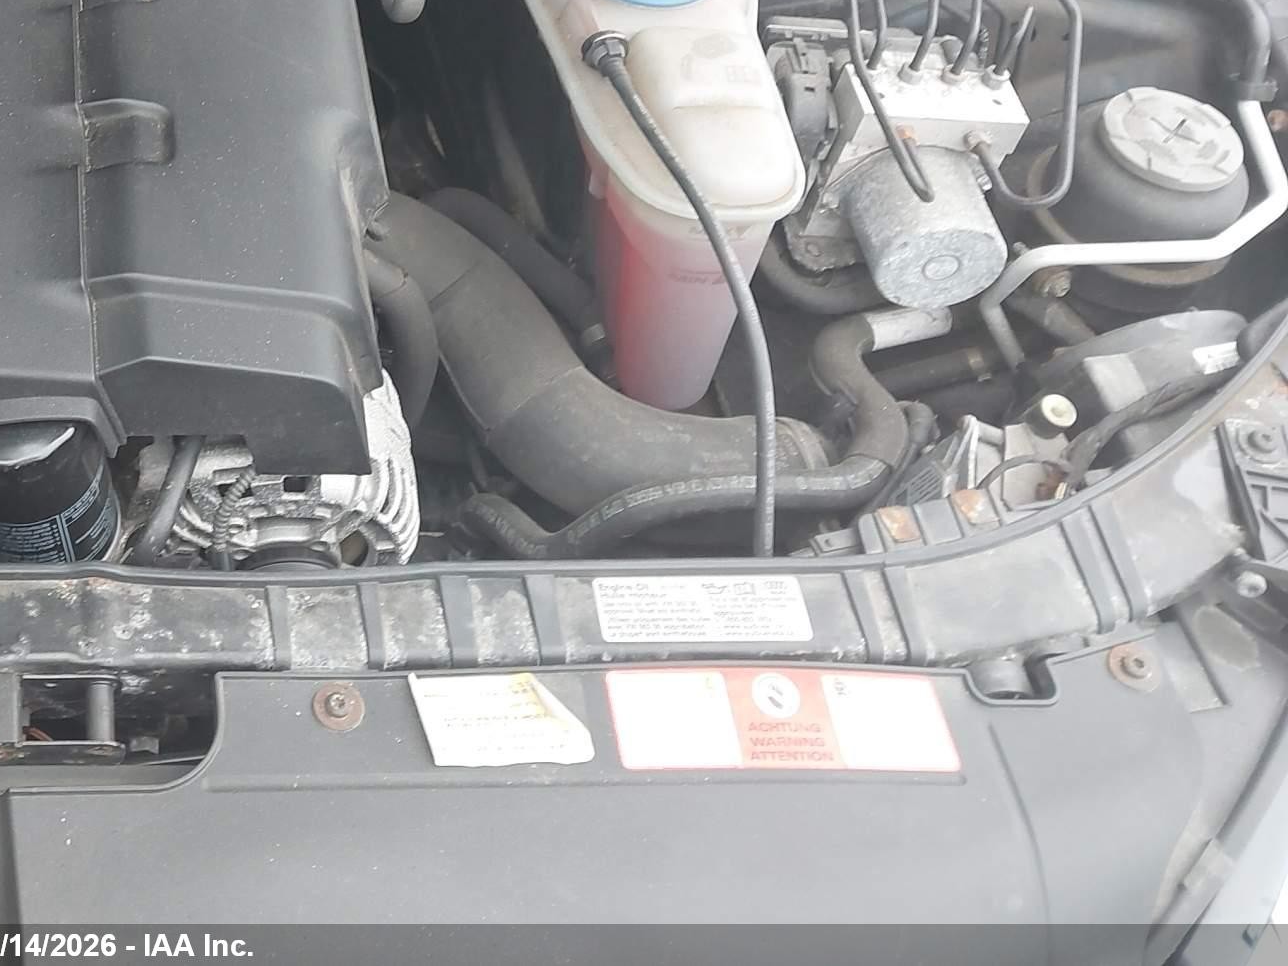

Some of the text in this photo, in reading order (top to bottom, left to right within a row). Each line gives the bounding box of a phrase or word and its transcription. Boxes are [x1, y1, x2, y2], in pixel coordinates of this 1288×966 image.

[748, 721, 822, 733] ACHTUNG
[749, 736, 825, 747] WARNING
[750, 750, 834, 762] ATTENTION
